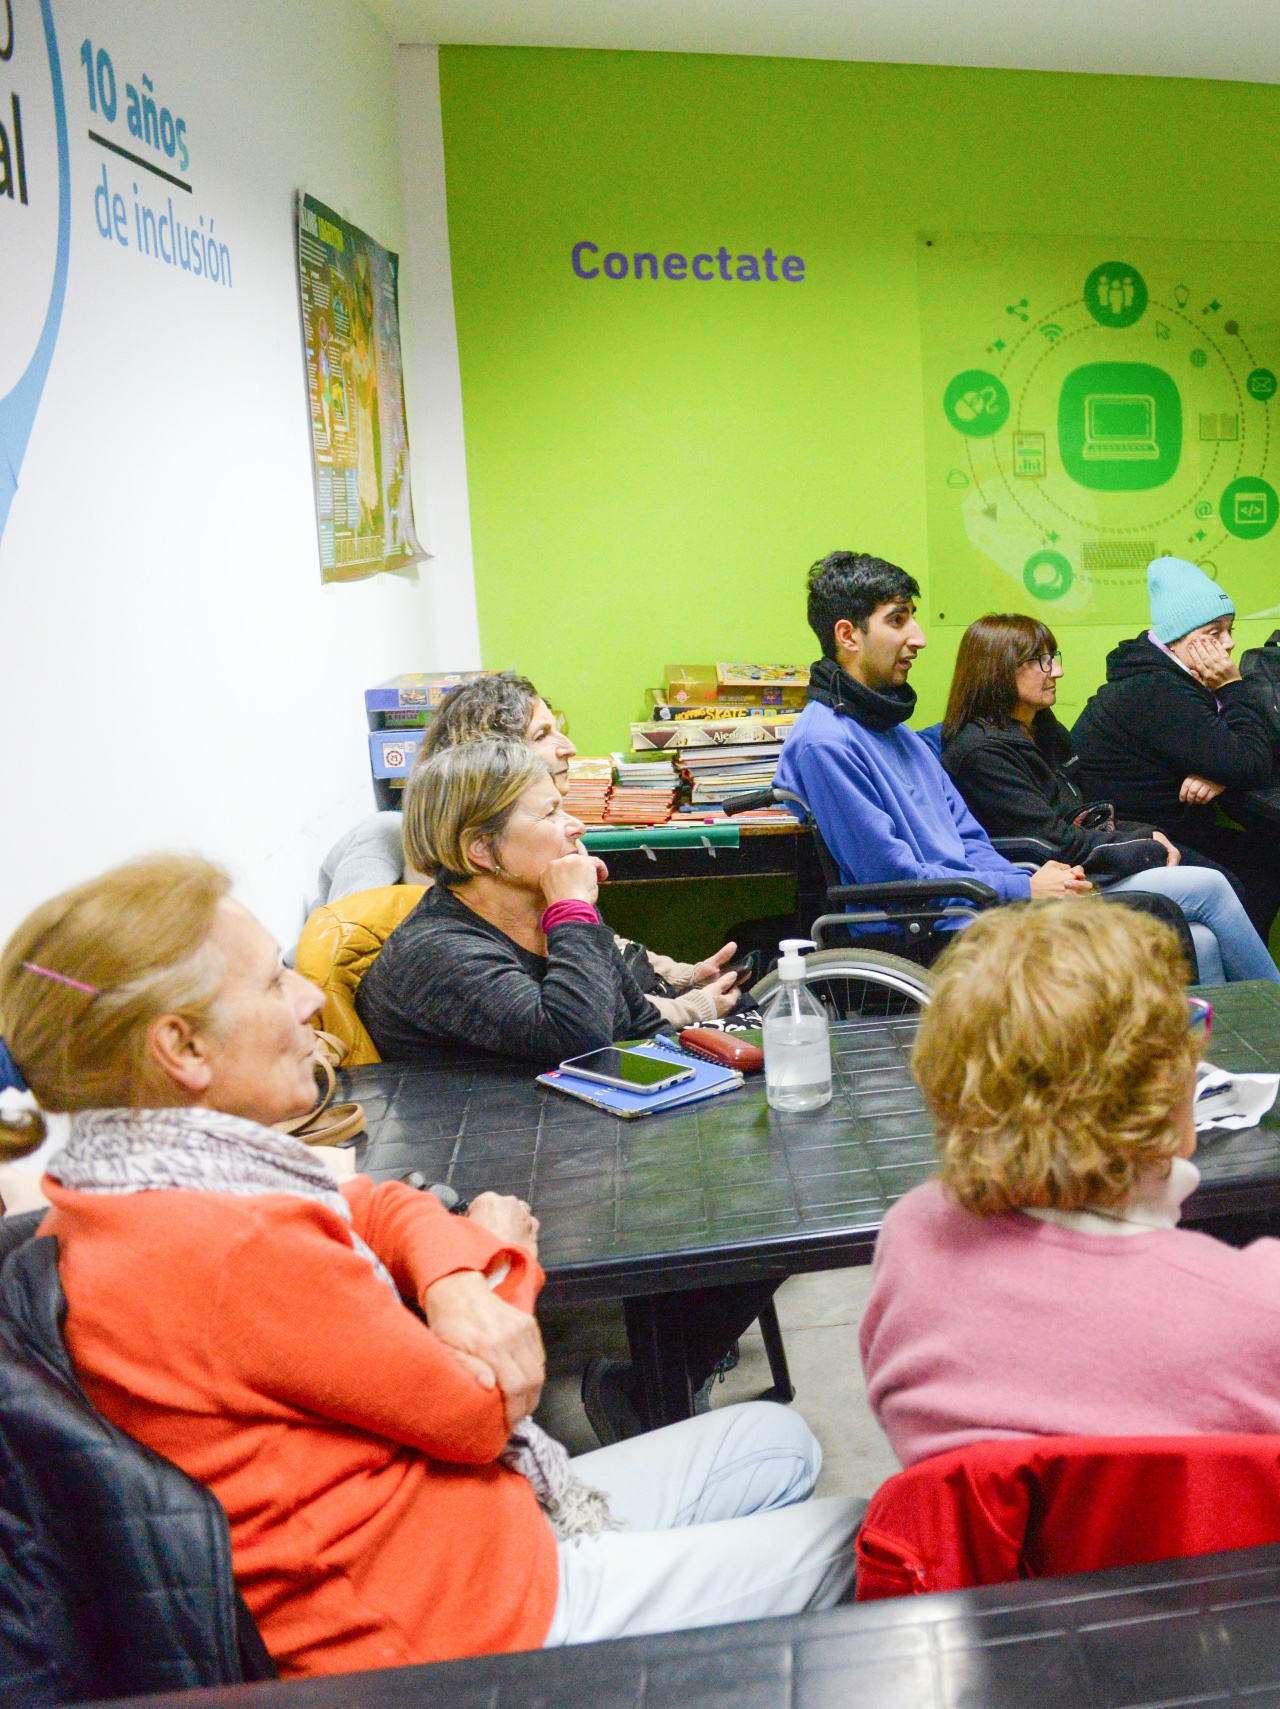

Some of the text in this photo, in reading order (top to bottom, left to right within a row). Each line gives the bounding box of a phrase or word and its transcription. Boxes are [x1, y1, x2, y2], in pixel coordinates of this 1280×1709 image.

[80, 38, 190, 172] 10 años
[95, 163, 129, 247] de
[132, 182, 233, 289] inclusión
[571, 241, 806, 282] Conectate
[705, 707, 747, 720] SKATE
